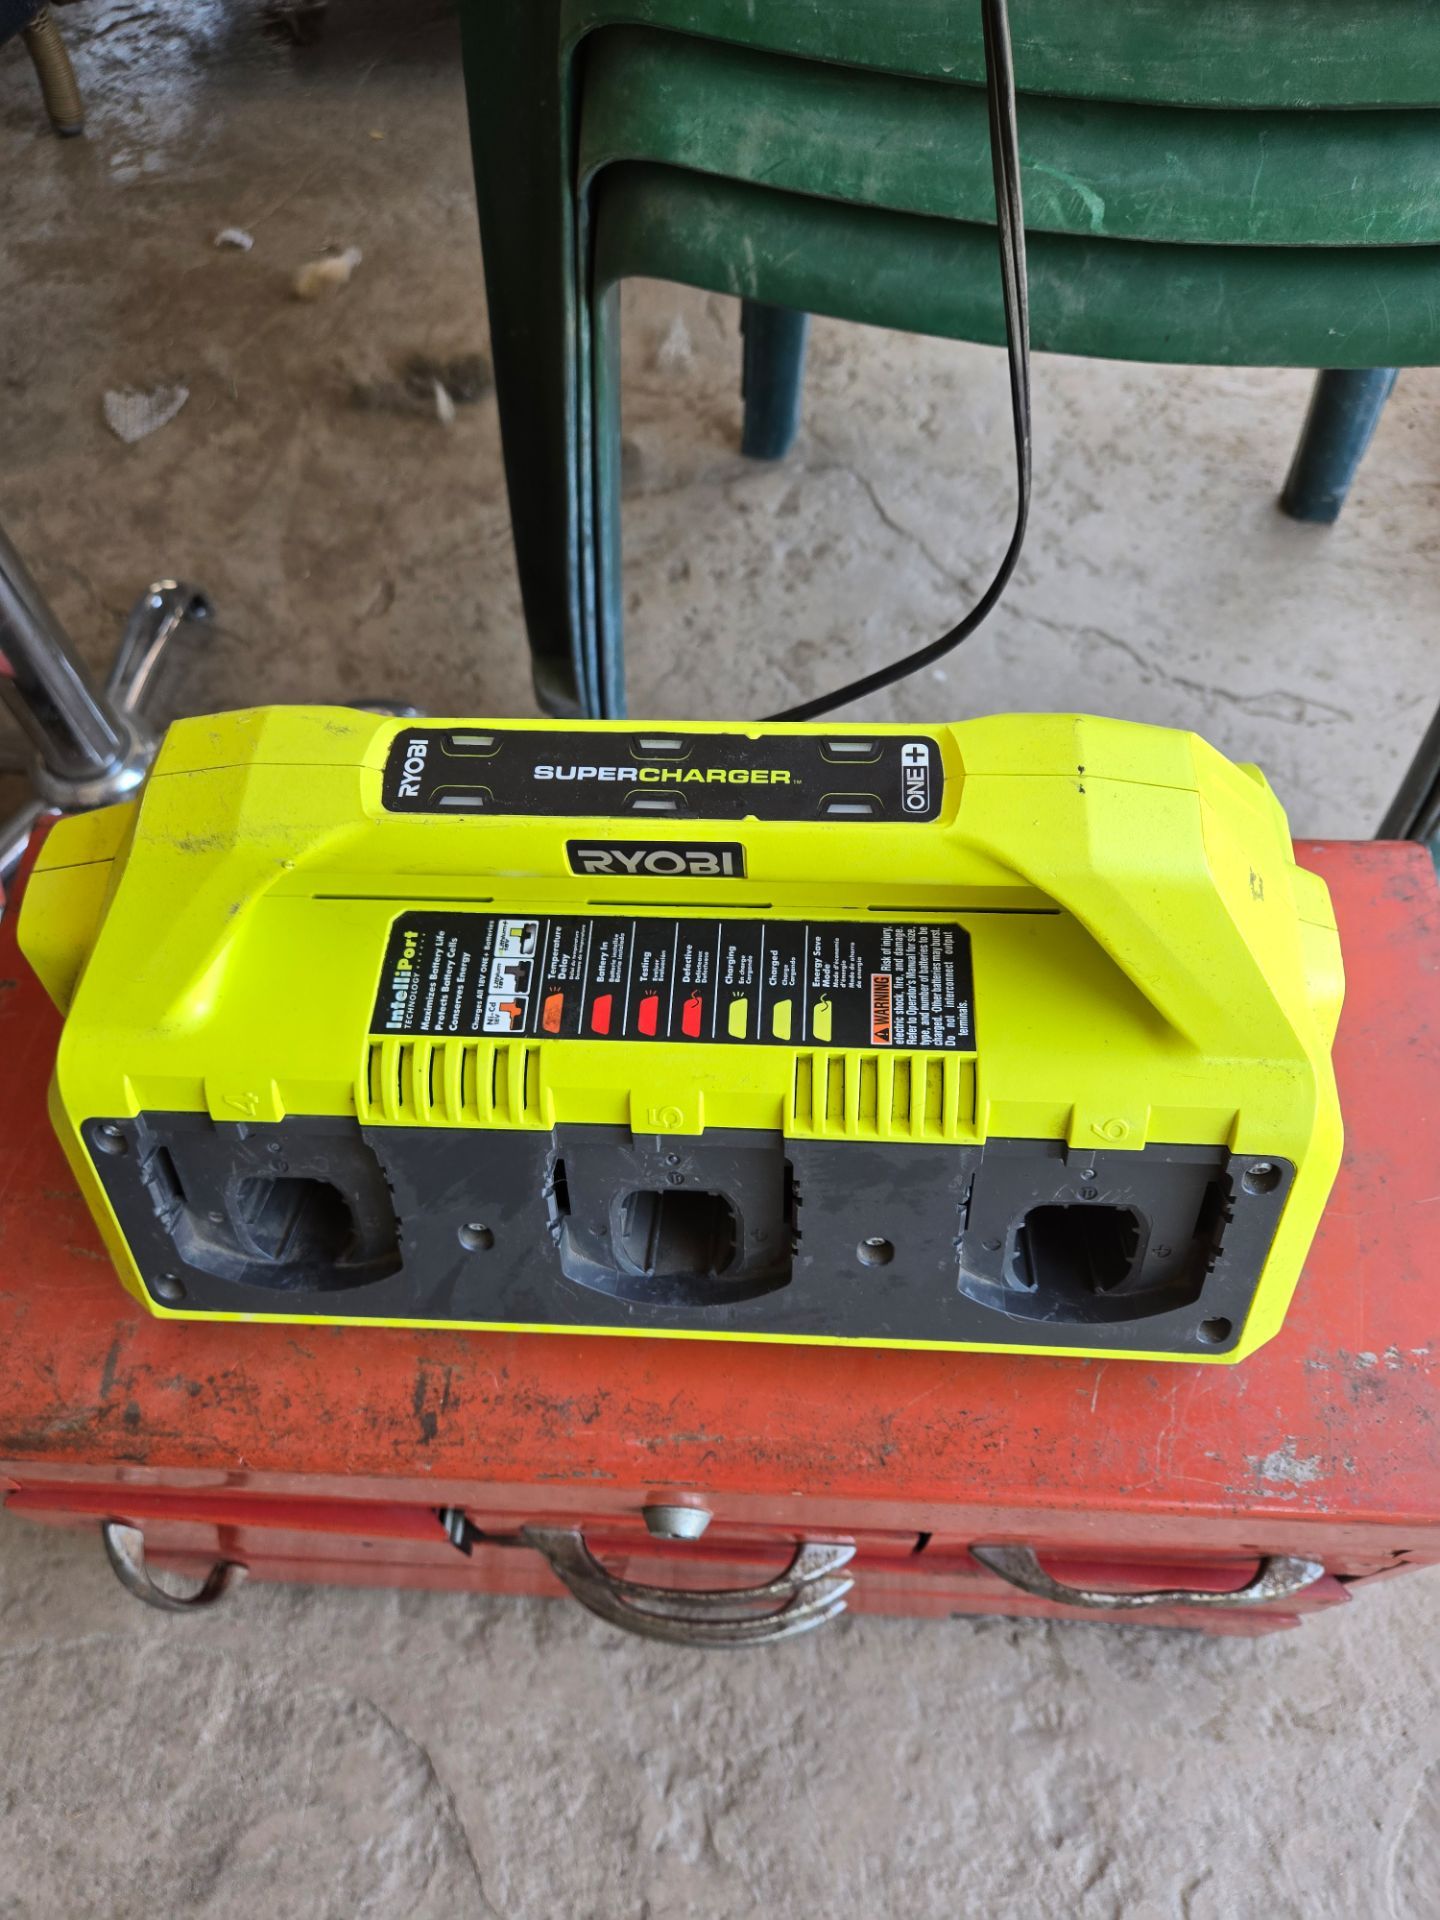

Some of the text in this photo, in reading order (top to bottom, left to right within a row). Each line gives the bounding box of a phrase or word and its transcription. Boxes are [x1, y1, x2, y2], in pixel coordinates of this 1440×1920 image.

[398, 740, 428, 797] RYOBI
[534, 766, 790, 784] SUPERCHARGER
[905, 746, 926, 810] ONE+
[578, 850, 733, 875] RYOBI
[906, 926, 916, 942] size,
[919, 927, 928, 935] be
[548, 926, 562, 979] Temperature
[597, 941, 609, 983] Battery In
[812, 936, 822, 987] Energy Save
[906, 943, 916, 952] for
[919, 945, 928, 974] batteries
[472, 920, 494, 1030] Charges All 18V ONE+ Batteries
[493, 963, 501, 989] Lithium
[558, 954, 571, 980] Delay
[639, 951, 651, 982] Testing
[682, 944, 693, 983] Defective
[725, 945, 737, 984] Charging
[769, 949, 780, 986] Charged
[823, 964, 831, 988] Mode
[881, 957, 891, 971] Risk
[906, 954, 916, 979] Manual
[386, 931, 419, 1029] IntelliPort
[421, 930, 446, 1030] Maximizes Battery Life
[435, 938, 458, 1031] Protects Battery Cells
[449, 952, 471, 1031] Conserves Energy
[739, 976, 745, 984] En
[894, 926, 905, 1045] electric shock, fire, and damage.
[931, 927, 945, 1046] charged. Other batteries may burst.
[944, 931, 956, 1046] Do not interconnect output
[405, 972, 420, 1029] TECHNOLOGY
[873, 976, 890, 1025] WARNING
[906, 980, 919, 1016] Operator's
[919, 984, 929, 1010] number
[486, 1002, 497, 1025] Ni-Cd
[920, 1013, 929, 1025] and
[957, 1000, 969, 1036] terminals.
[907, 1025, 917, 1045] Refer
[920, 1027, 932, 1045] type,
[221, 1092, 259, 1116] 4
[647, 1105, 684, 1129] 5
[1090, 1118, 1130, 1142] 6
